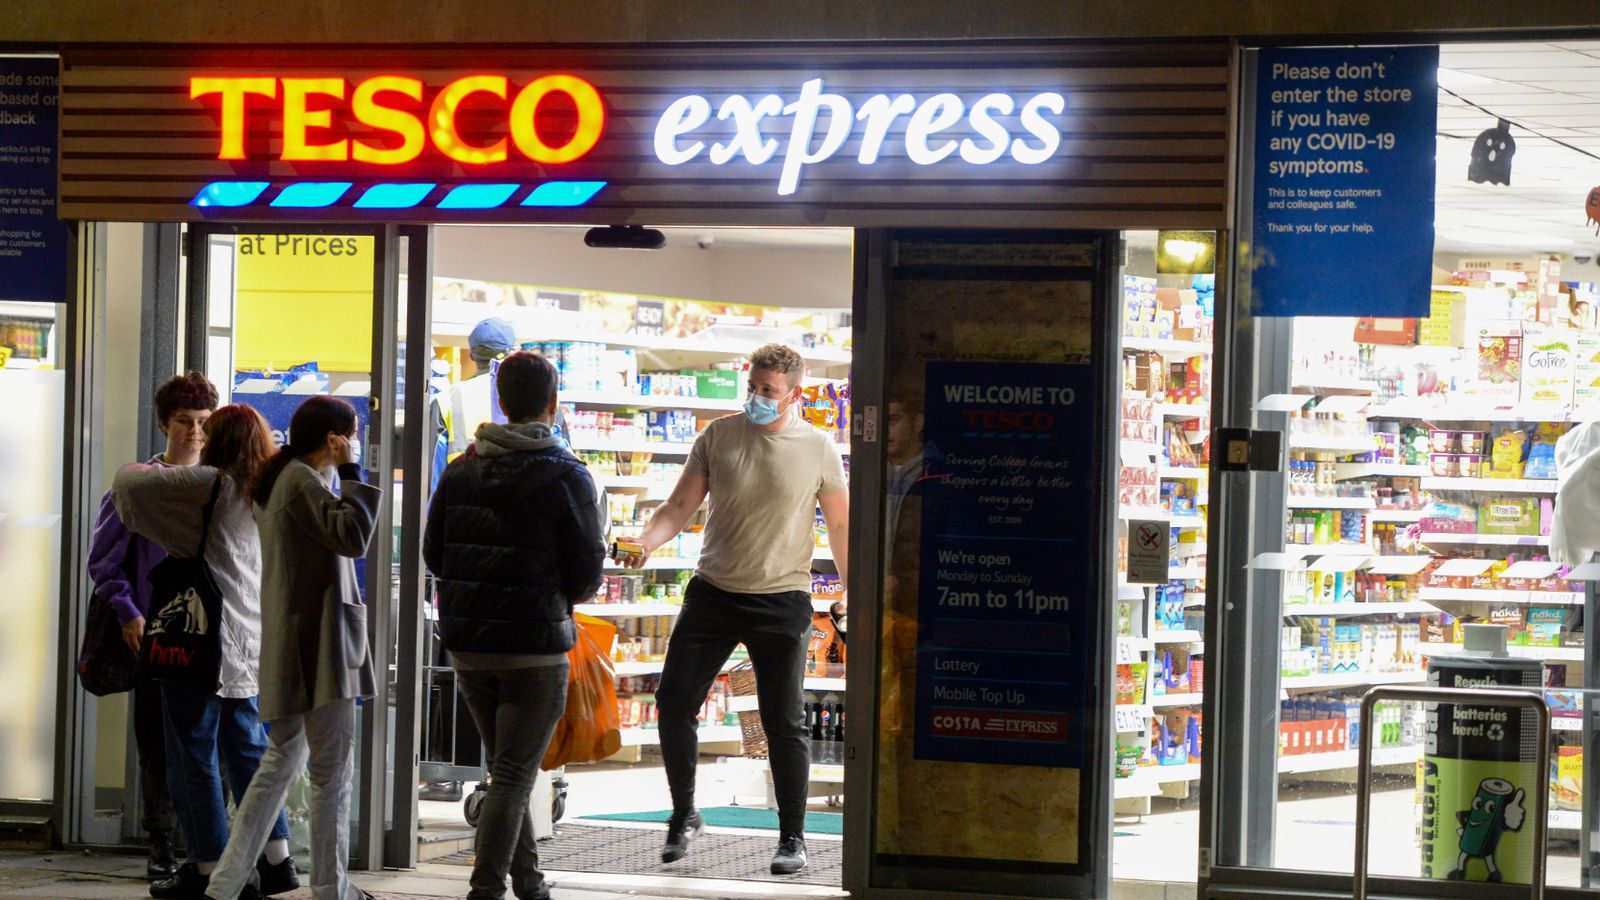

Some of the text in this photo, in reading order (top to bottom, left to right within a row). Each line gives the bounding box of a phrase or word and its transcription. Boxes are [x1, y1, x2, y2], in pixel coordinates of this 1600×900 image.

[1272, 62, 1386, 80] Please don't
[0, 92, 41, 106] based
[1271, 86, 1412, 103] enter the store
[1271, 110, 1370, 130] if you have
[190, 74, 1066, 195] TESCO express
[1270, 133, 1395, 154] any COVID-19
[1269, 158, 1369, 177] symptoms.
[1268, 188, 1381, 199] This is to keep customers
[1268, 200, 1357, 211] and colleagues safe.
[31, 230, 42, 238] for
[1268, 223, 1374, 234] Thank you for your help.
[9, 240, 46, 248] customers
[239, 234, 358, 256] at Prices
[944, 385, 1075, 405] WELCOME TO
[962, 410, 1055, 432] TESCO
[944, 454, 986, 473] Serving
[988, 455, 1027, 474] College
[1000, 475, 1034, 487] little
[1037, 475, 1073, 488] better
[977, 494, 1034, 511] every day
[937, 550, 1011, 568] We're open
[937, 569, 1032, 586] Monday to Sunday
[937, 586, 1069, 614] 7am to 11pm
[149, 639, 197, 668] hmv
[935, 657, 980, 674] Lottery
[934, 686, 1025, 706] Mobile Top Up
[1453, 705, 1508, 721] batteries
[933, 716, 1058, 734] COSTA EXPRESS
[1452, 721, 1484, 736] here!
